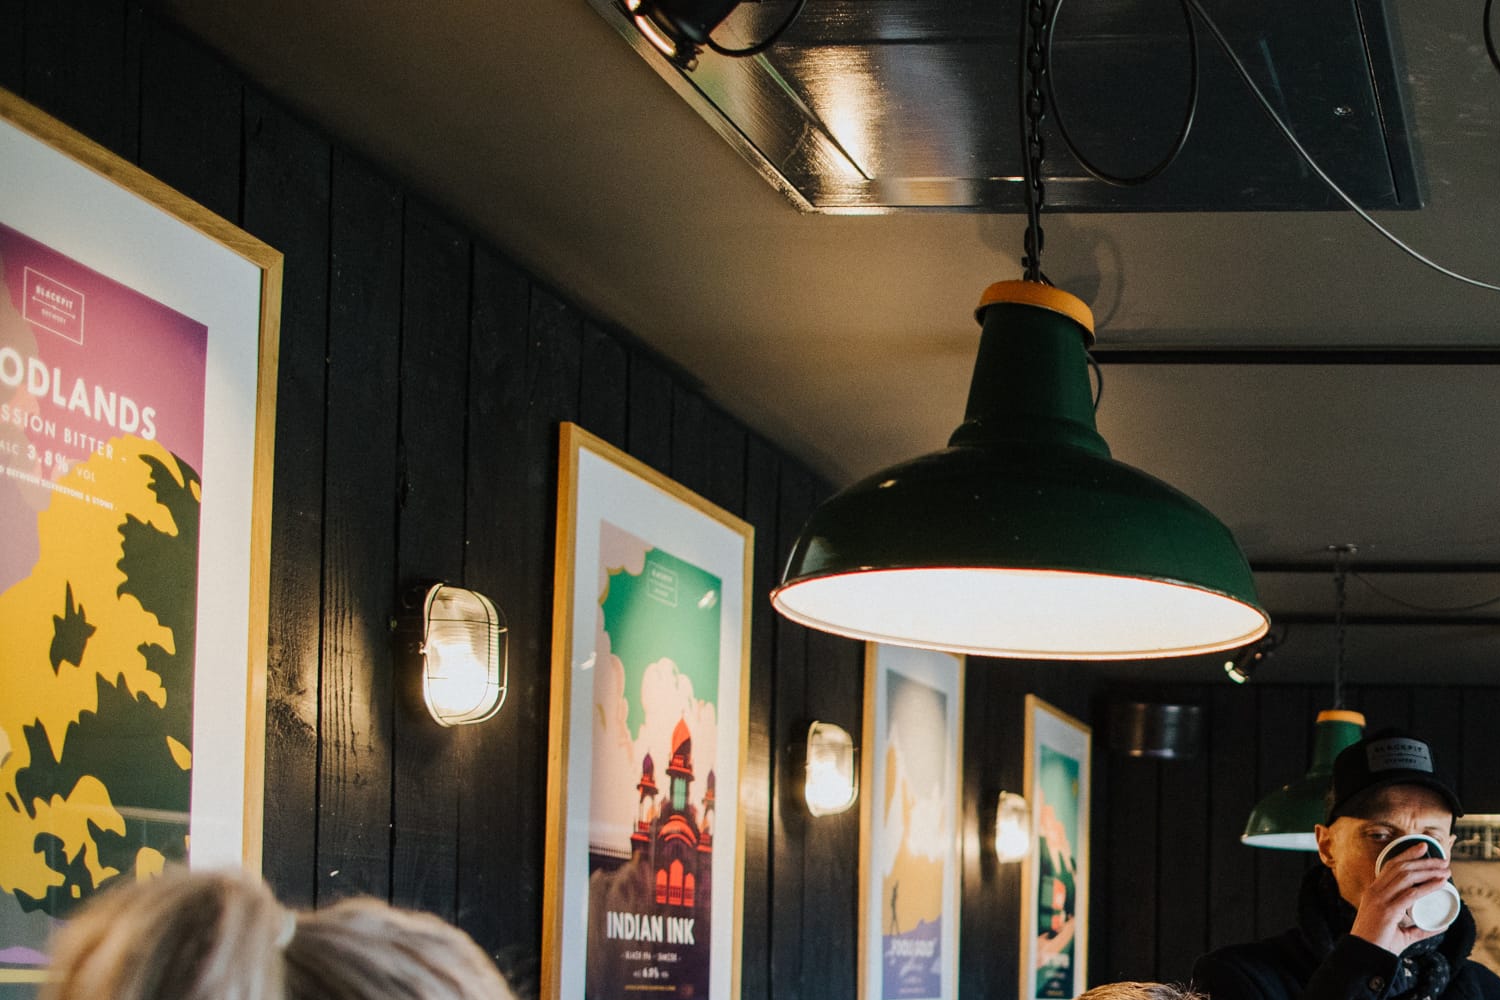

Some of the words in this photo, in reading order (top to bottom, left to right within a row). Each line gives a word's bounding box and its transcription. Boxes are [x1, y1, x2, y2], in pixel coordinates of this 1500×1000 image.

[63, 427, 114, 461] BITTER
[27, 444, 69, 473] 3.8%
[76, 466, 96, 484] VOL
[607, 911, 663, 942] INDIAN
[666, 916, 695, 945] INK
